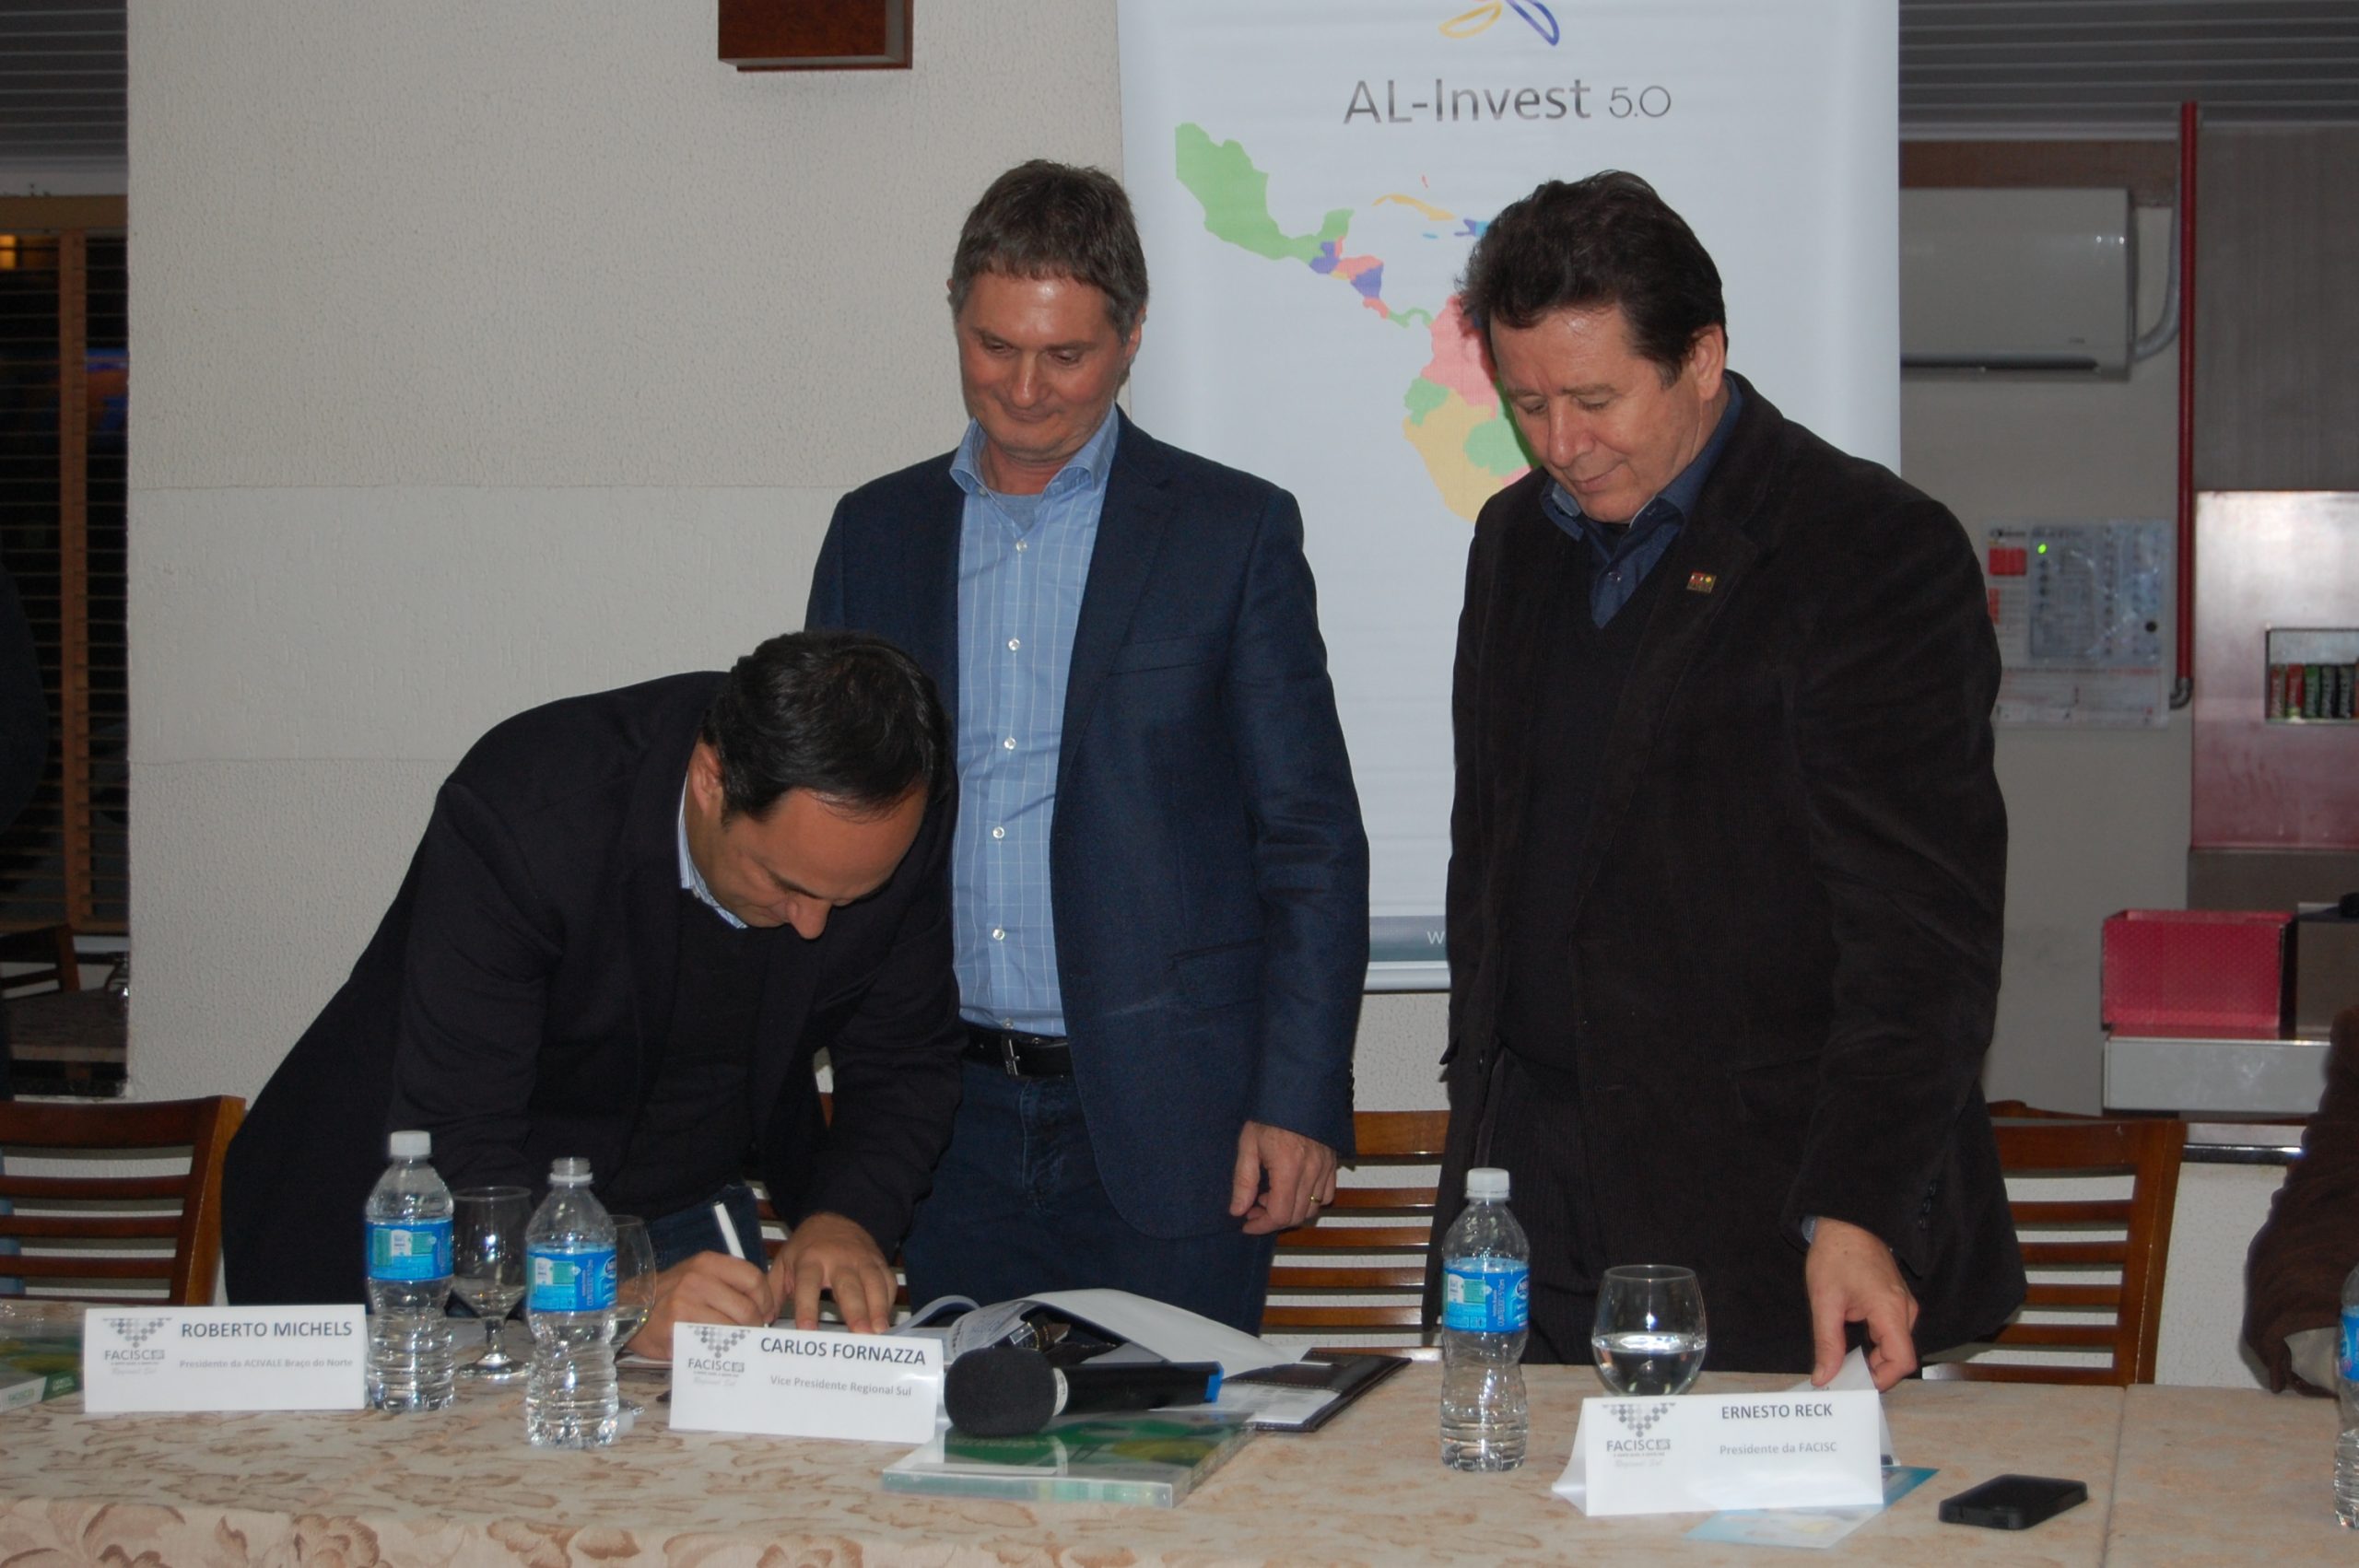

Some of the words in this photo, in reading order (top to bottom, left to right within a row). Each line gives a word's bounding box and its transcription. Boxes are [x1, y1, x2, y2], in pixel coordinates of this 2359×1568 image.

[1343, 77, 1591, 124] AL-Invest
[1608, 85, 1672, 119] 5.0
[182, 1322, 267, 1337] ROBERTO
[274, 1321, 353, 1337] MICHELS
[103, 1349, 149, 1361] FACISC
[760, 1337, 827, 1357] CARLOS
[833, 1343, 926, 1365] FORNAZZA
[180, 1359, 229, 1368] Presidente
[230, 1359, 241, 1367] da
[244, 1359, 281, 1367] ACIVALE
[285, 1359, 310, 1369] Braço
[311, 1359, 323, 1367] do
[327, 1358, 353, 1367] Norte
[687, 1357, 731, 1372] FACISC
[770, 1375, 791, 1387] Vice
[794, 1377, 848, 1391] Presidente
[850, 1382, 894, 1395] Regional
[897, 1387, 911, 1397] Sul
[1721, 1405, 1790, 1420] ERNESTO
[1795, 1403, 1833, 1417] RECK
[1606, 1439, 1655, 1452] FACISC
[1719, 1444, 1778, 1455] Presidente
[1782, 1443, 1796, 1453] da
[1799, 1442, 1837, 1453] FACISC
